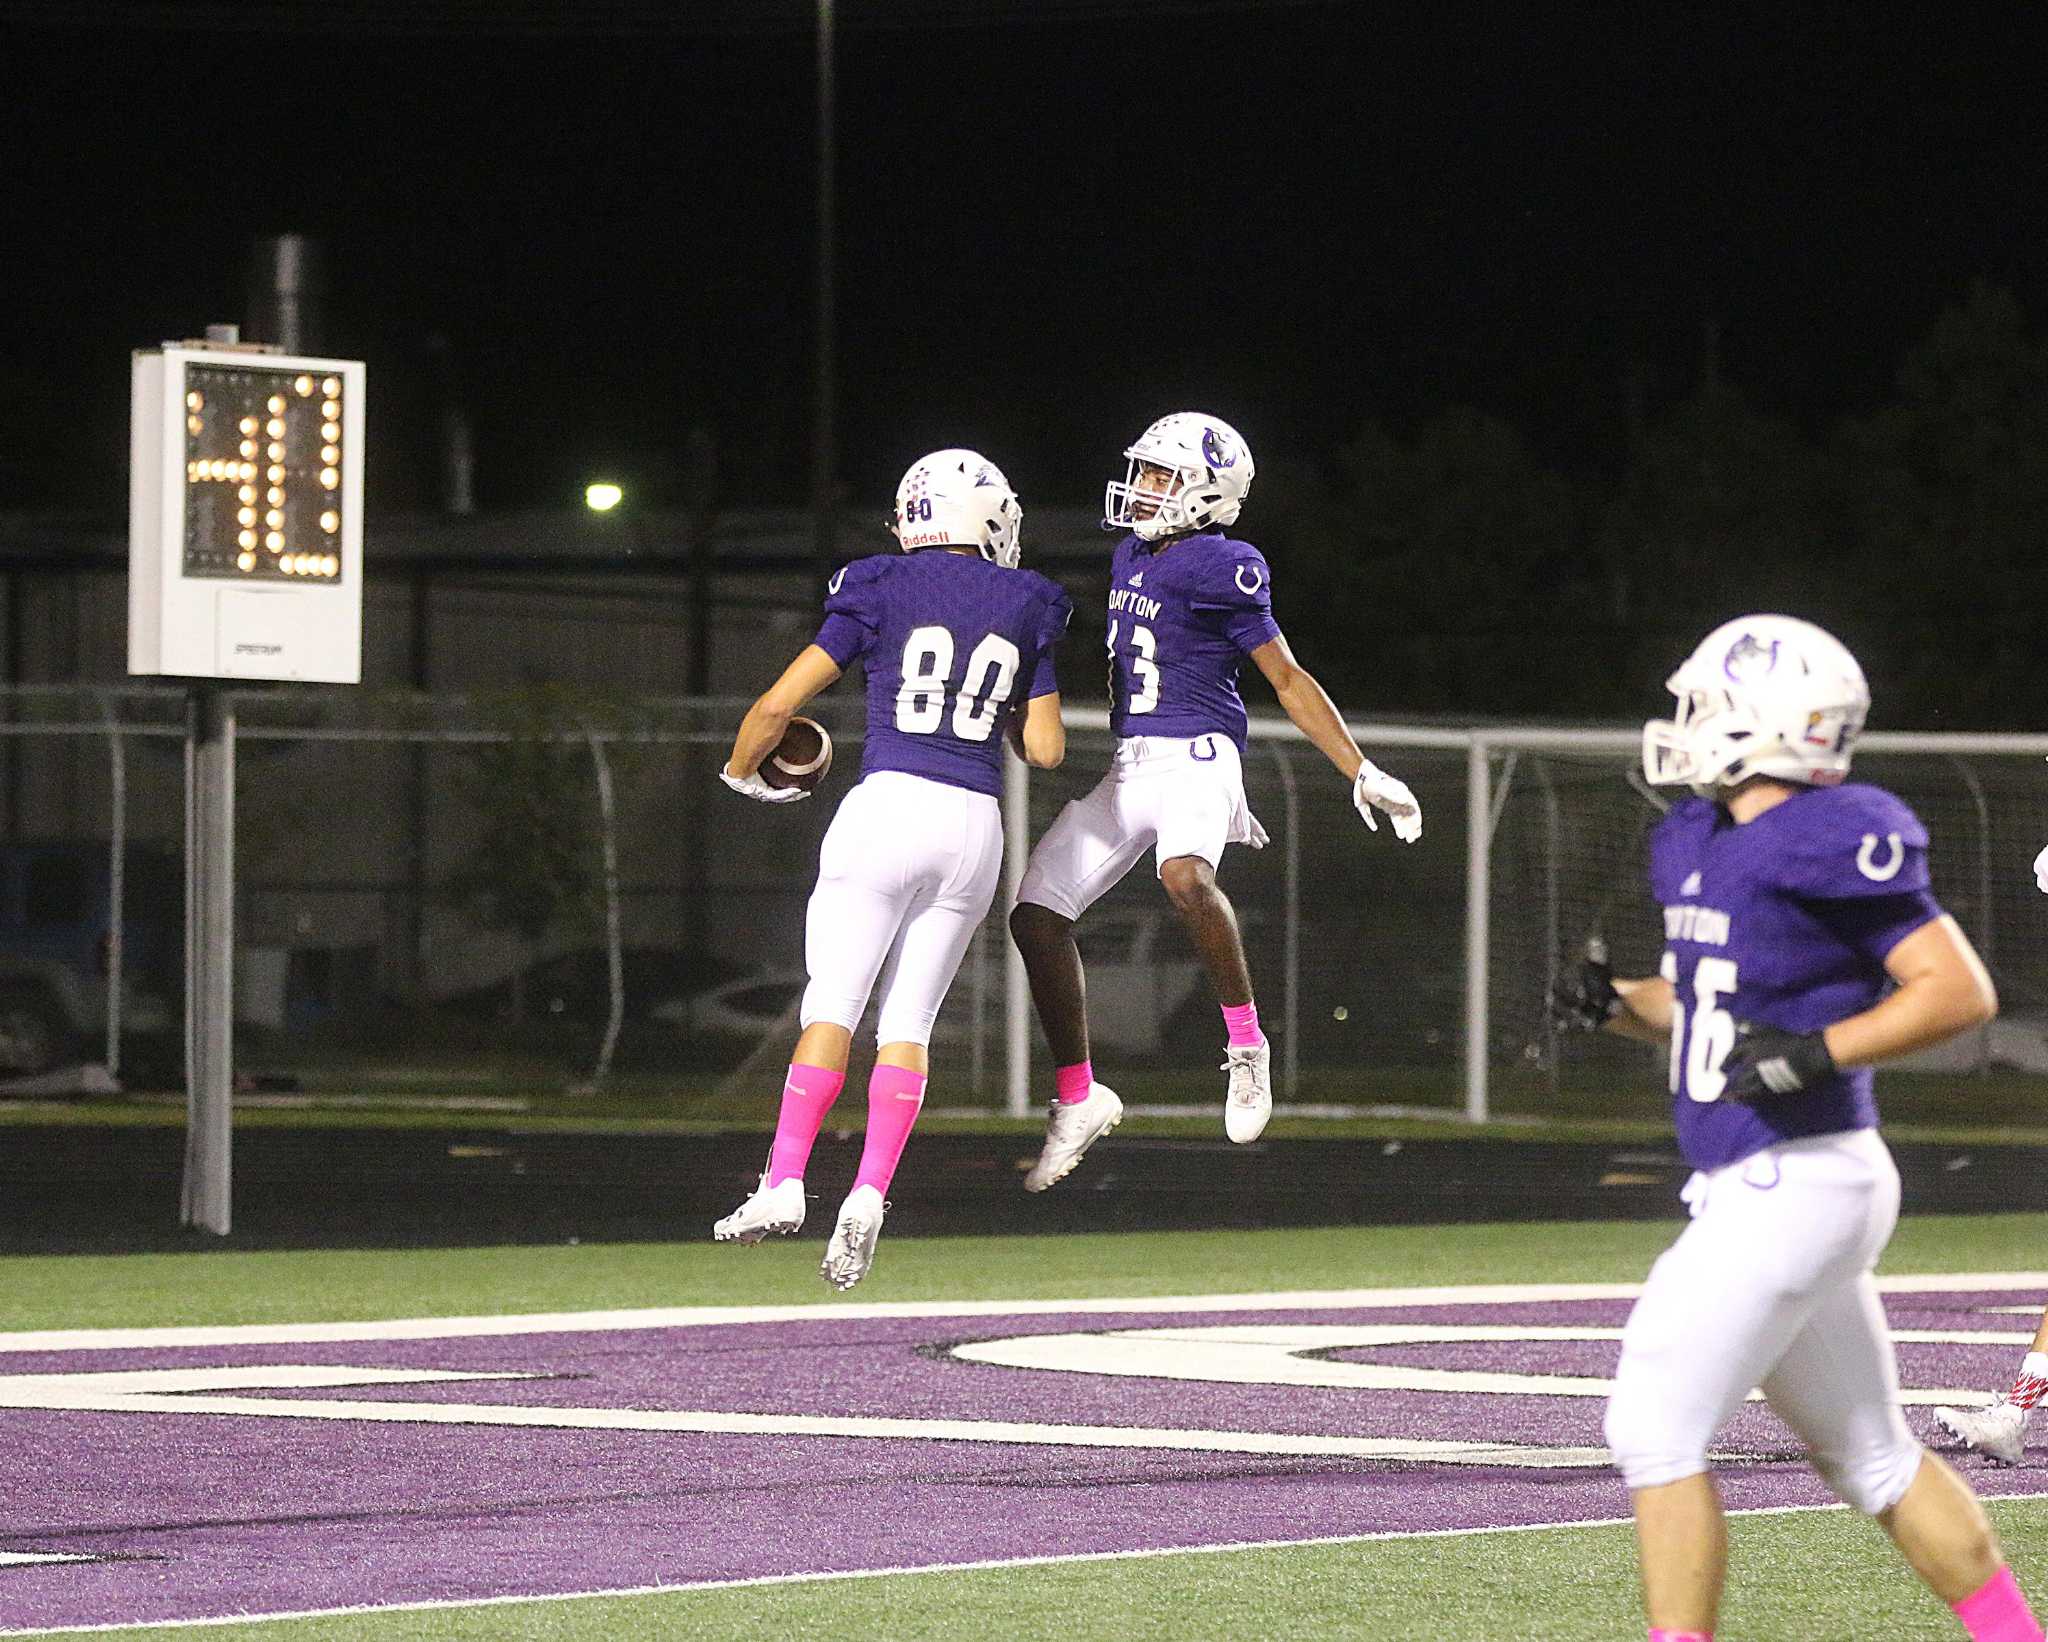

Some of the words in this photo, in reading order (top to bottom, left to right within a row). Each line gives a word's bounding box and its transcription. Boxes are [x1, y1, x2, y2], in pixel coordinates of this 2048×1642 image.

[906, 498, 933, 523] 80
[902, 531, 950, 549] Riddell
[1108, 588, 1162, 621] DAYTON
[895, 625, 1020, 741] 80
